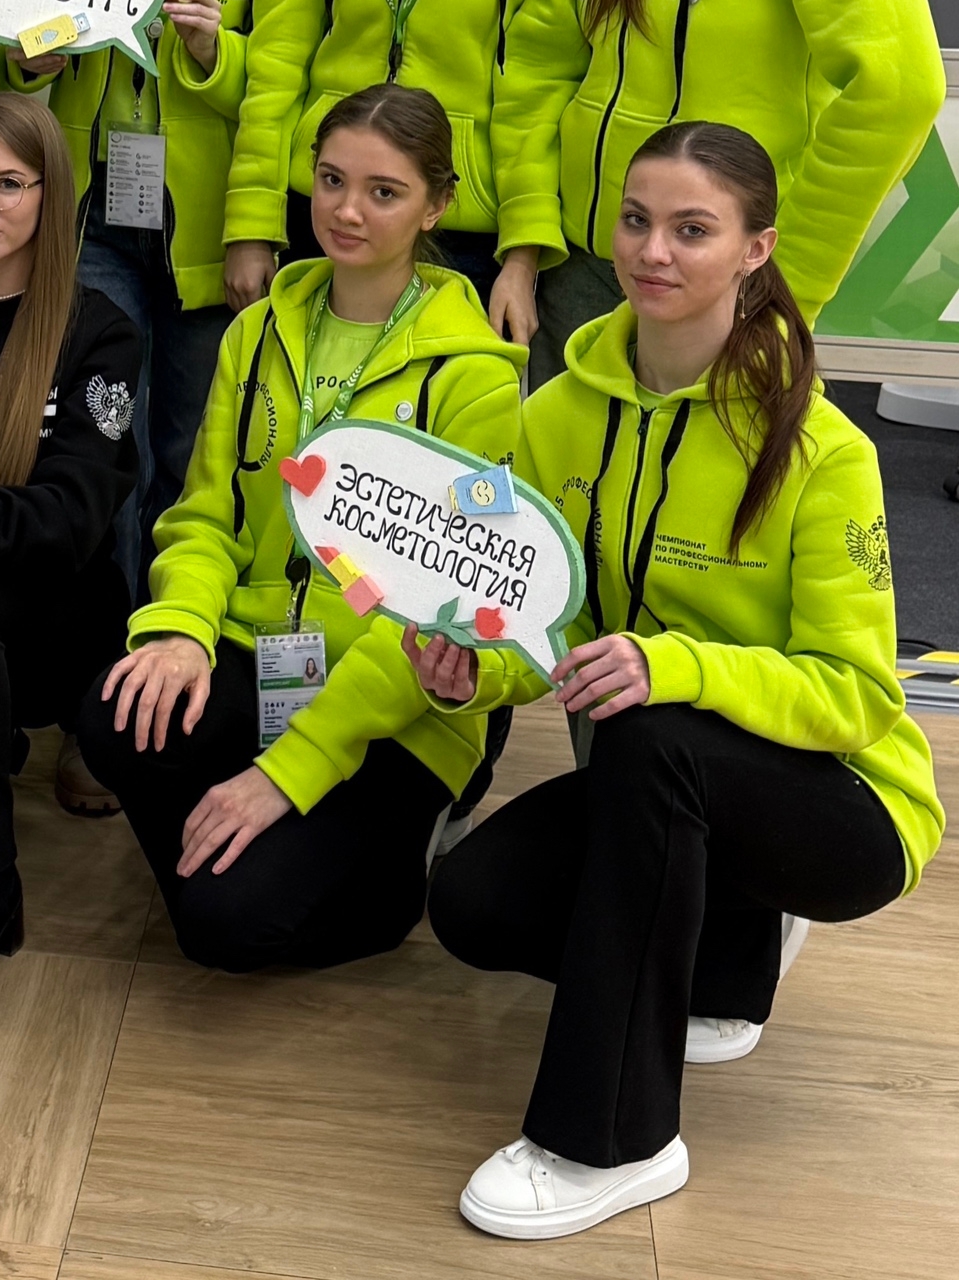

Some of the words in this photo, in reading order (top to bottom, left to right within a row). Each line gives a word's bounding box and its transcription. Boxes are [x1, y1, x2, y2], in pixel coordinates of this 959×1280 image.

[335, 463, 537, 578] ЭСТЕТИЧЕСКАЯ
[323, 494, 528, 612] КОСМЕТОЛОГИЯ
[655, 534, 708, 551] ЧЕМПИОНАТ
[654, 544, 668, 553] ПО
[668, 546, 769, 570] ПРОФЕССИОНАЛЬНОМУ
[654, 555, 710, 572] МАСТЕРСТВУ
